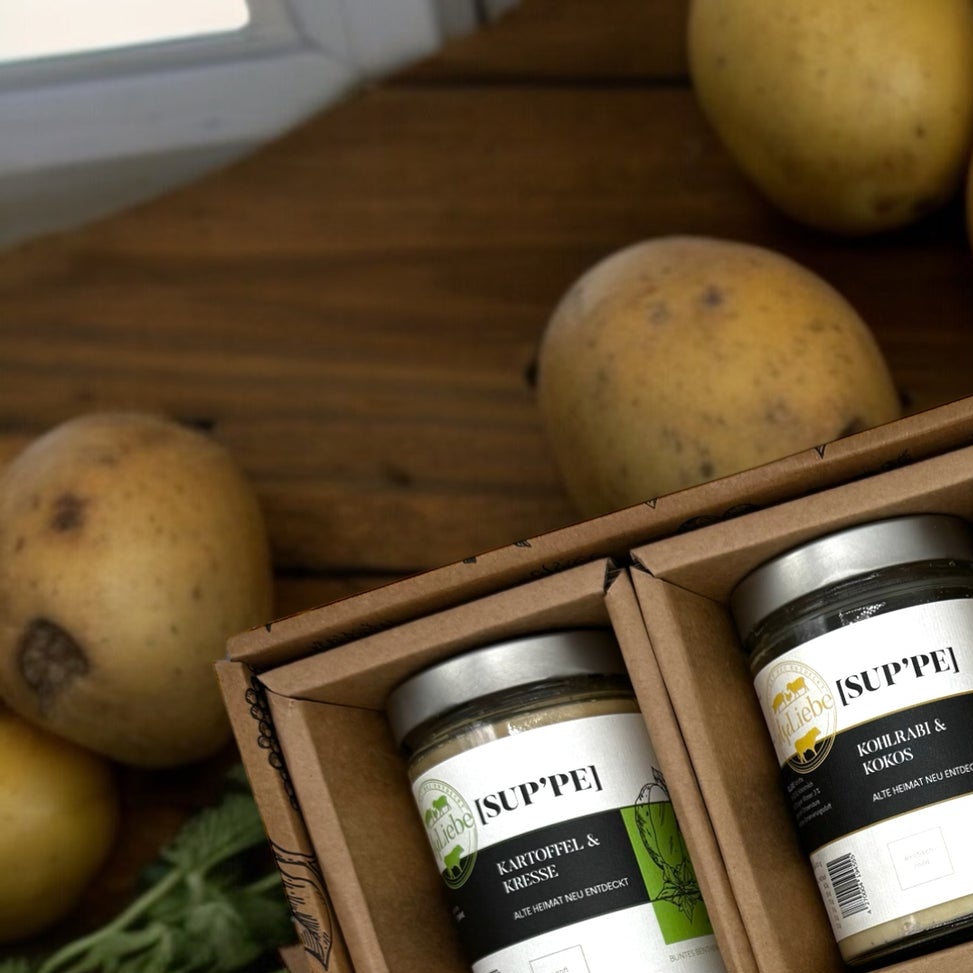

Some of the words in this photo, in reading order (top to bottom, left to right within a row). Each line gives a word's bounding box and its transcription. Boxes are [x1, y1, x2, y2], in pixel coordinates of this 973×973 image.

[857, 725, 931, 758] KOHLRABI
[934, 718, 947, 732] &
[862, 747, 914, 775] KOKOS
[872, 788, 892, 802] ALTE
[892, 776, 924, 795] HEIMAT
[925, 771, 944, 784] NEU
[496, 837, 584, 876] KARTOFFEL
[587, 833, 600, 847] &
[503, 864, 559, 893] KRESSE
[514, 906, 532, 920] ALTE
[533, 896, 564, 914] HEIMAT
[565, 891, 584, 903] NEU
[585, 877, 629, 897] ENTDECKT
